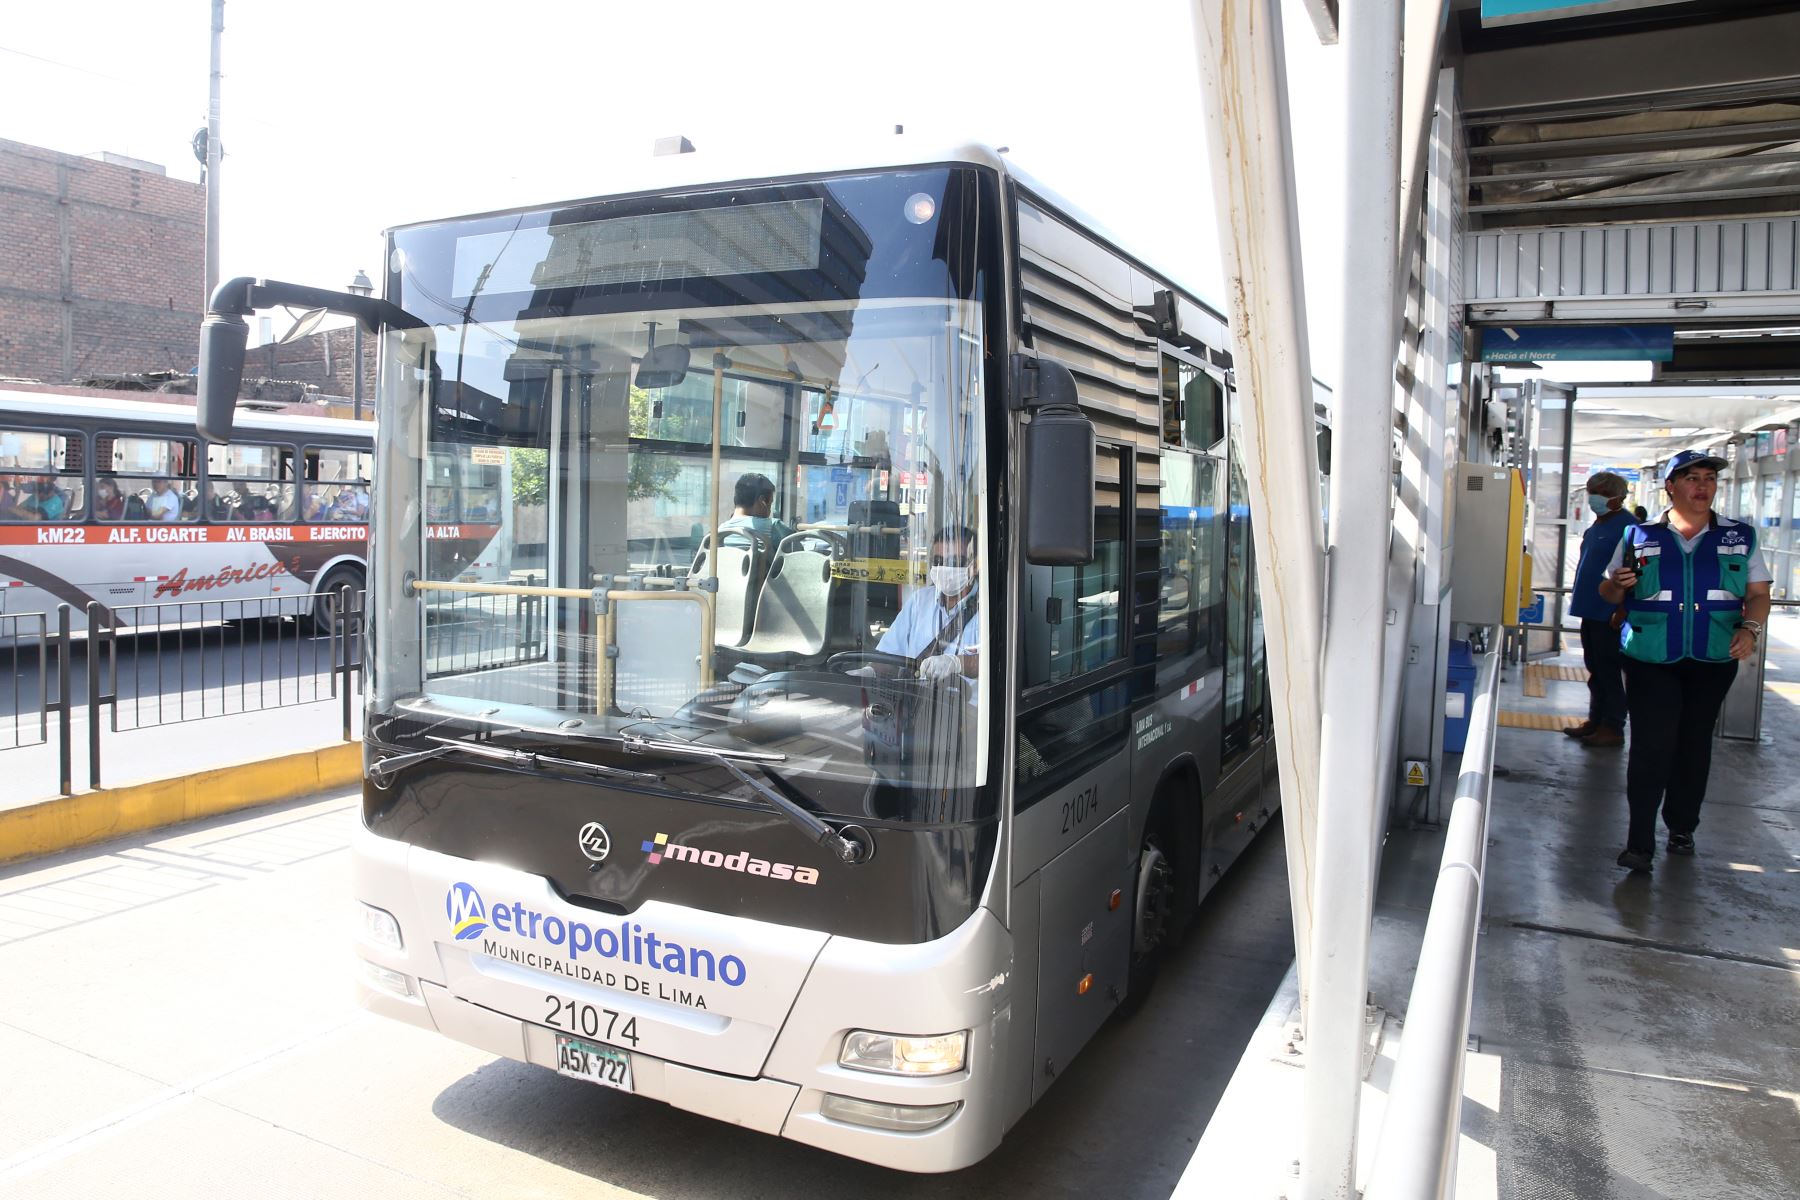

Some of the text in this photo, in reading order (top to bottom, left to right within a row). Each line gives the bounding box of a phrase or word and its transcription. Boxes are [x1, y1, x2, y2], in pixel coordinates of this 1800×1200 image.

[1490, 351, 1557, 360] Hacia el Norte
[108, 527, 208, 543] ALF. UGARTE
[226, 527, 294, 542] AV. BRASIL
[310, 526, 366, 540] EJERCITO
[437, 526, 461, 538] ALTA
[153, 561, 286, 598] América
[1062, 783, 1099, 835] 21074
[662, 842, 820, 886] modasa
[659, 982, 708, 1010] LIMA
[544, 995, 640, 1048] 21074
